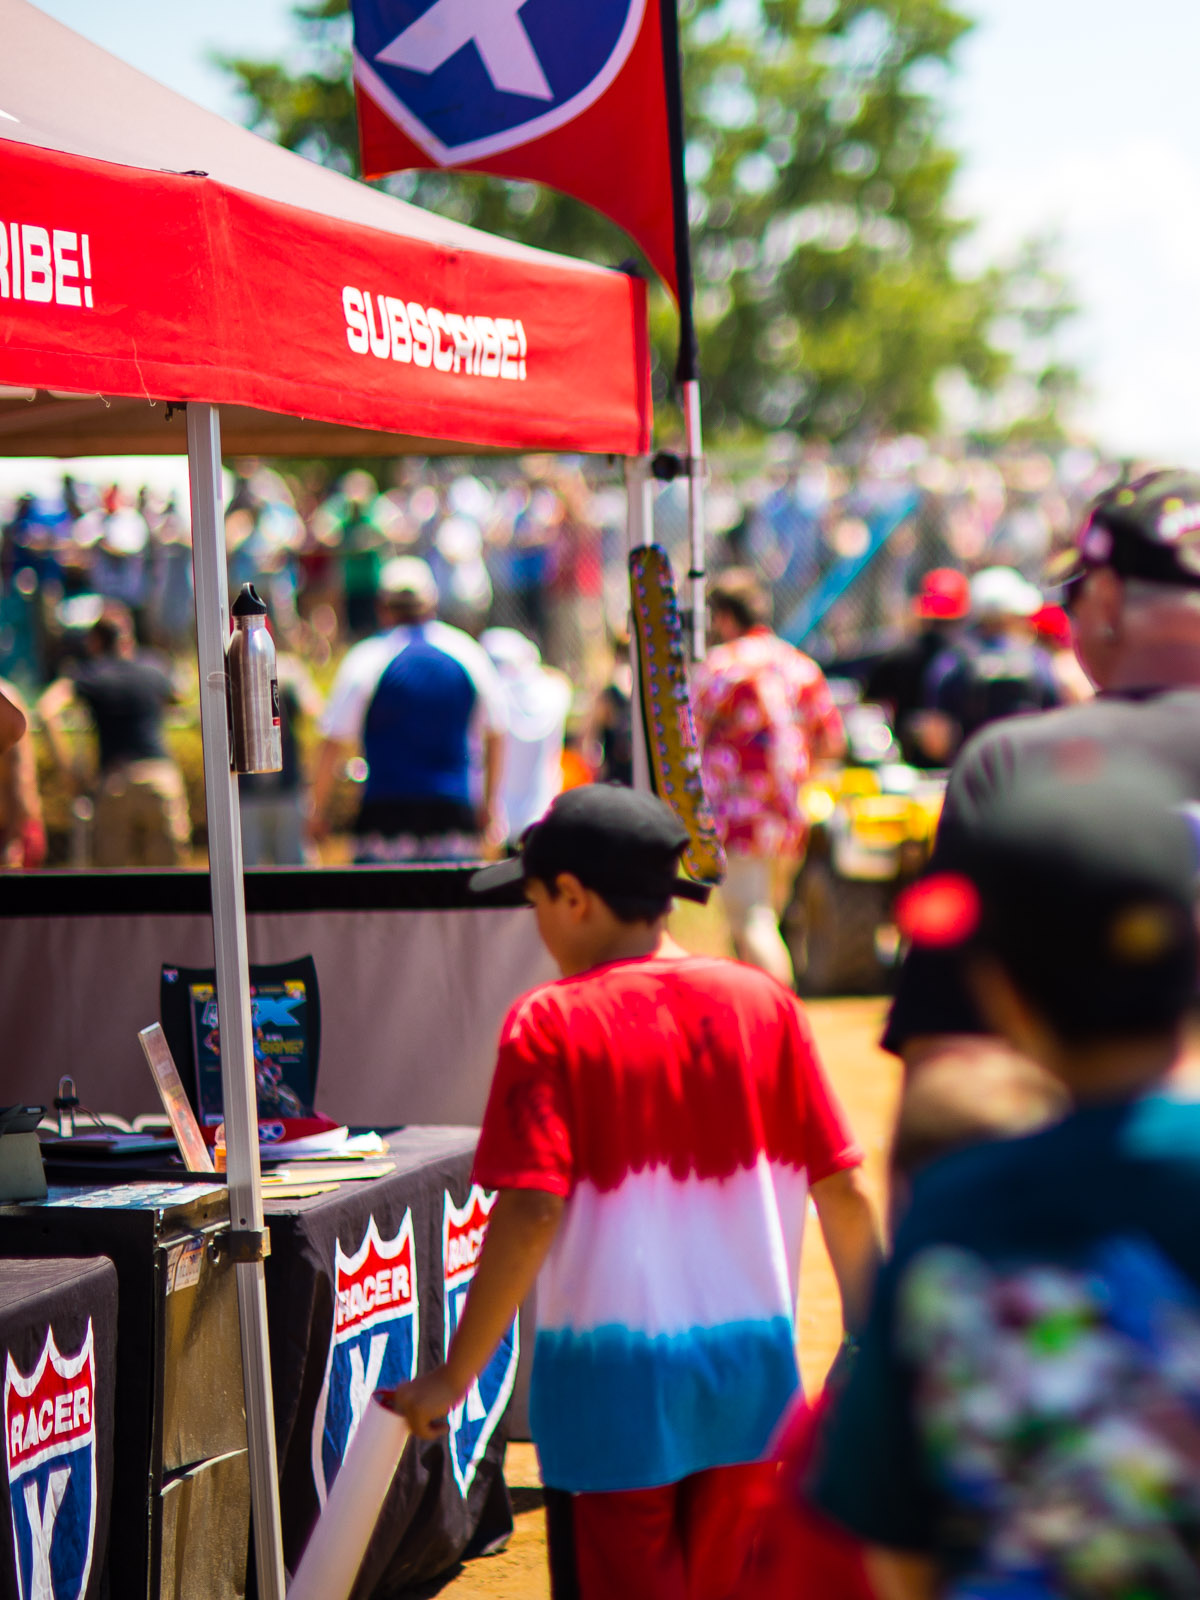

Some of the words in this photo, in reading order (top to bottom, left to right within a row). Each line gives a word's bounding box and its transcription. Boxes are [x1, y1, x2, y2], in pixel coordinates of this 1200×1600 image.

[342, 285, 527, 381] SUBSCRIBE!
[337, 1264, 411, 1327] RACER
[11, 1385, 90, 1458] RACER
